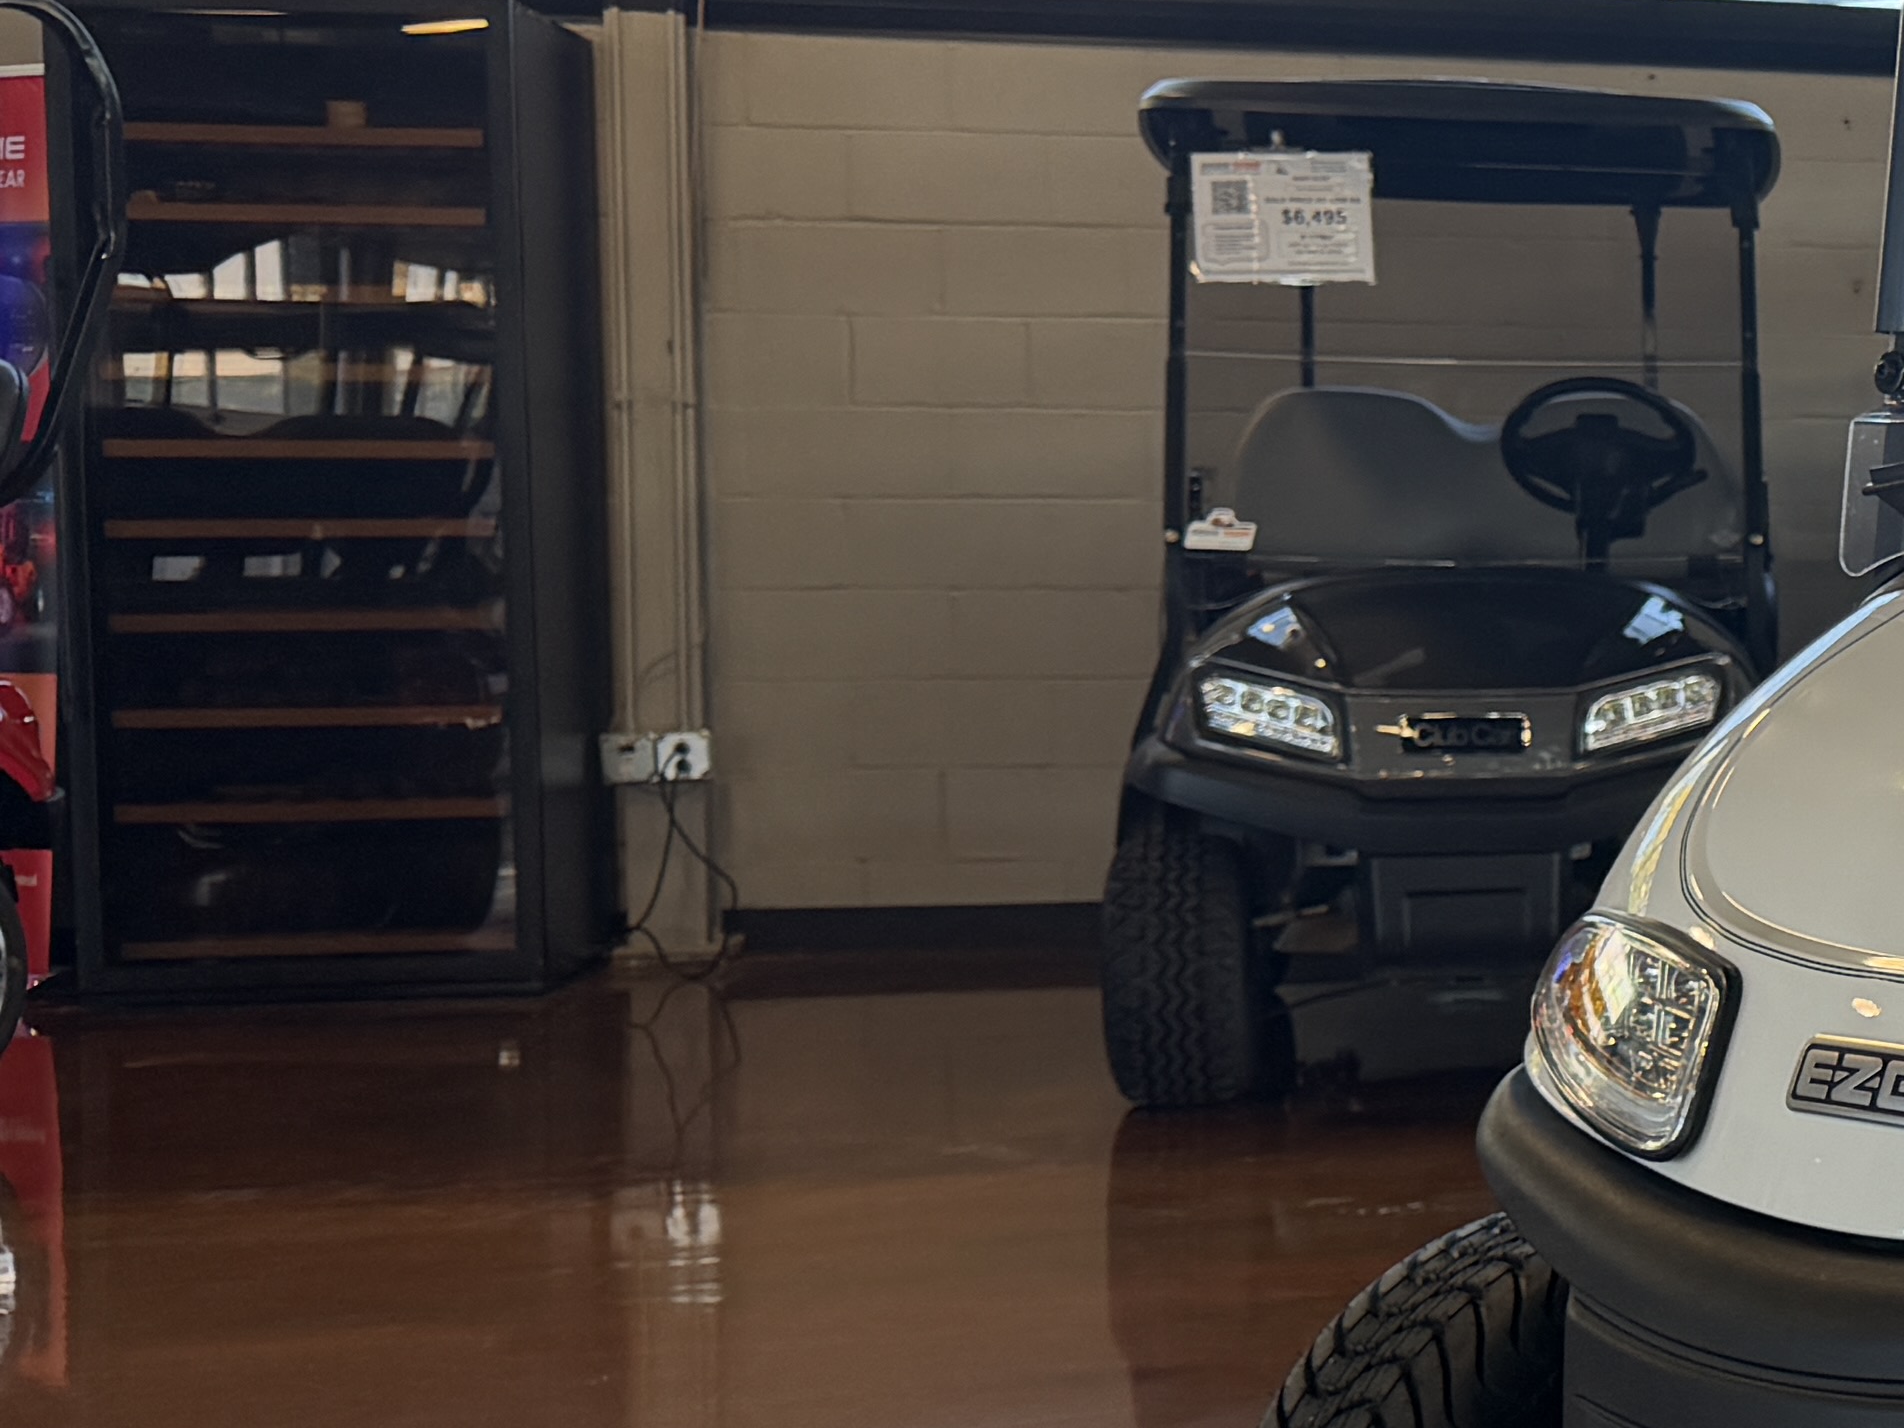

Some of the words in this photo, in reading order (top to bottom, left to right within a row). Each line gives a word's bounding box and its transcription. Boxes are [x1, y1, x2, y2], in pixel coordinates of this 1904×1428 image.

[1281, 207, 1347, 227] $6,495
[1414, 722, 1470, 748] Club
[1471, 722, 1518, 746] Car
